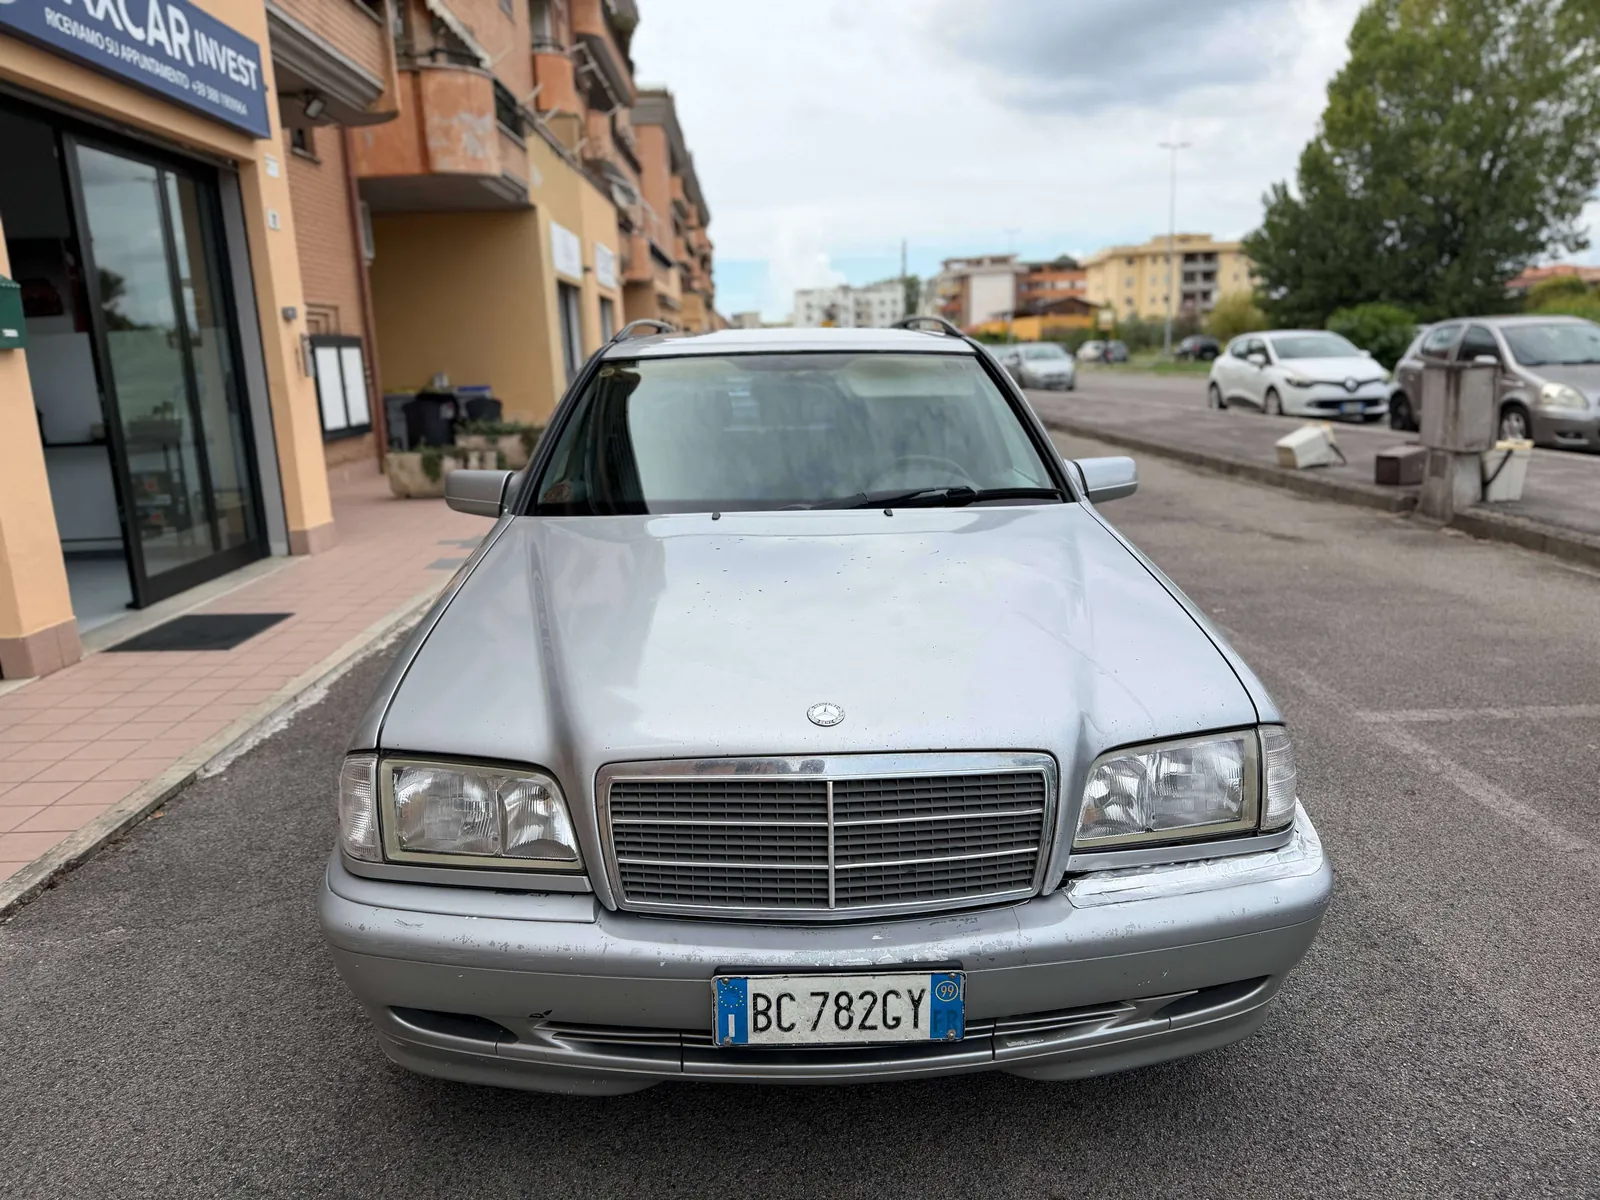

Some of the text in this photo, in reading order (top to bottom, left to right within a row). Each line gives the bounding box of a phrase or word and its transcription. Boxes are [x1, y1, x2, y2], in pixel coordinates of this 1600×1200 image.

[44, 6, 105, 50] RICEVIAMO
[105, 36, 120, 58] SU
[120, 44, 190, 90] APPUNTAMENTO
[194, 28, 257, 91] INVEST
[752, 988, 927, 1033] BC 782GY
[941, 985, 955, 998] 99
